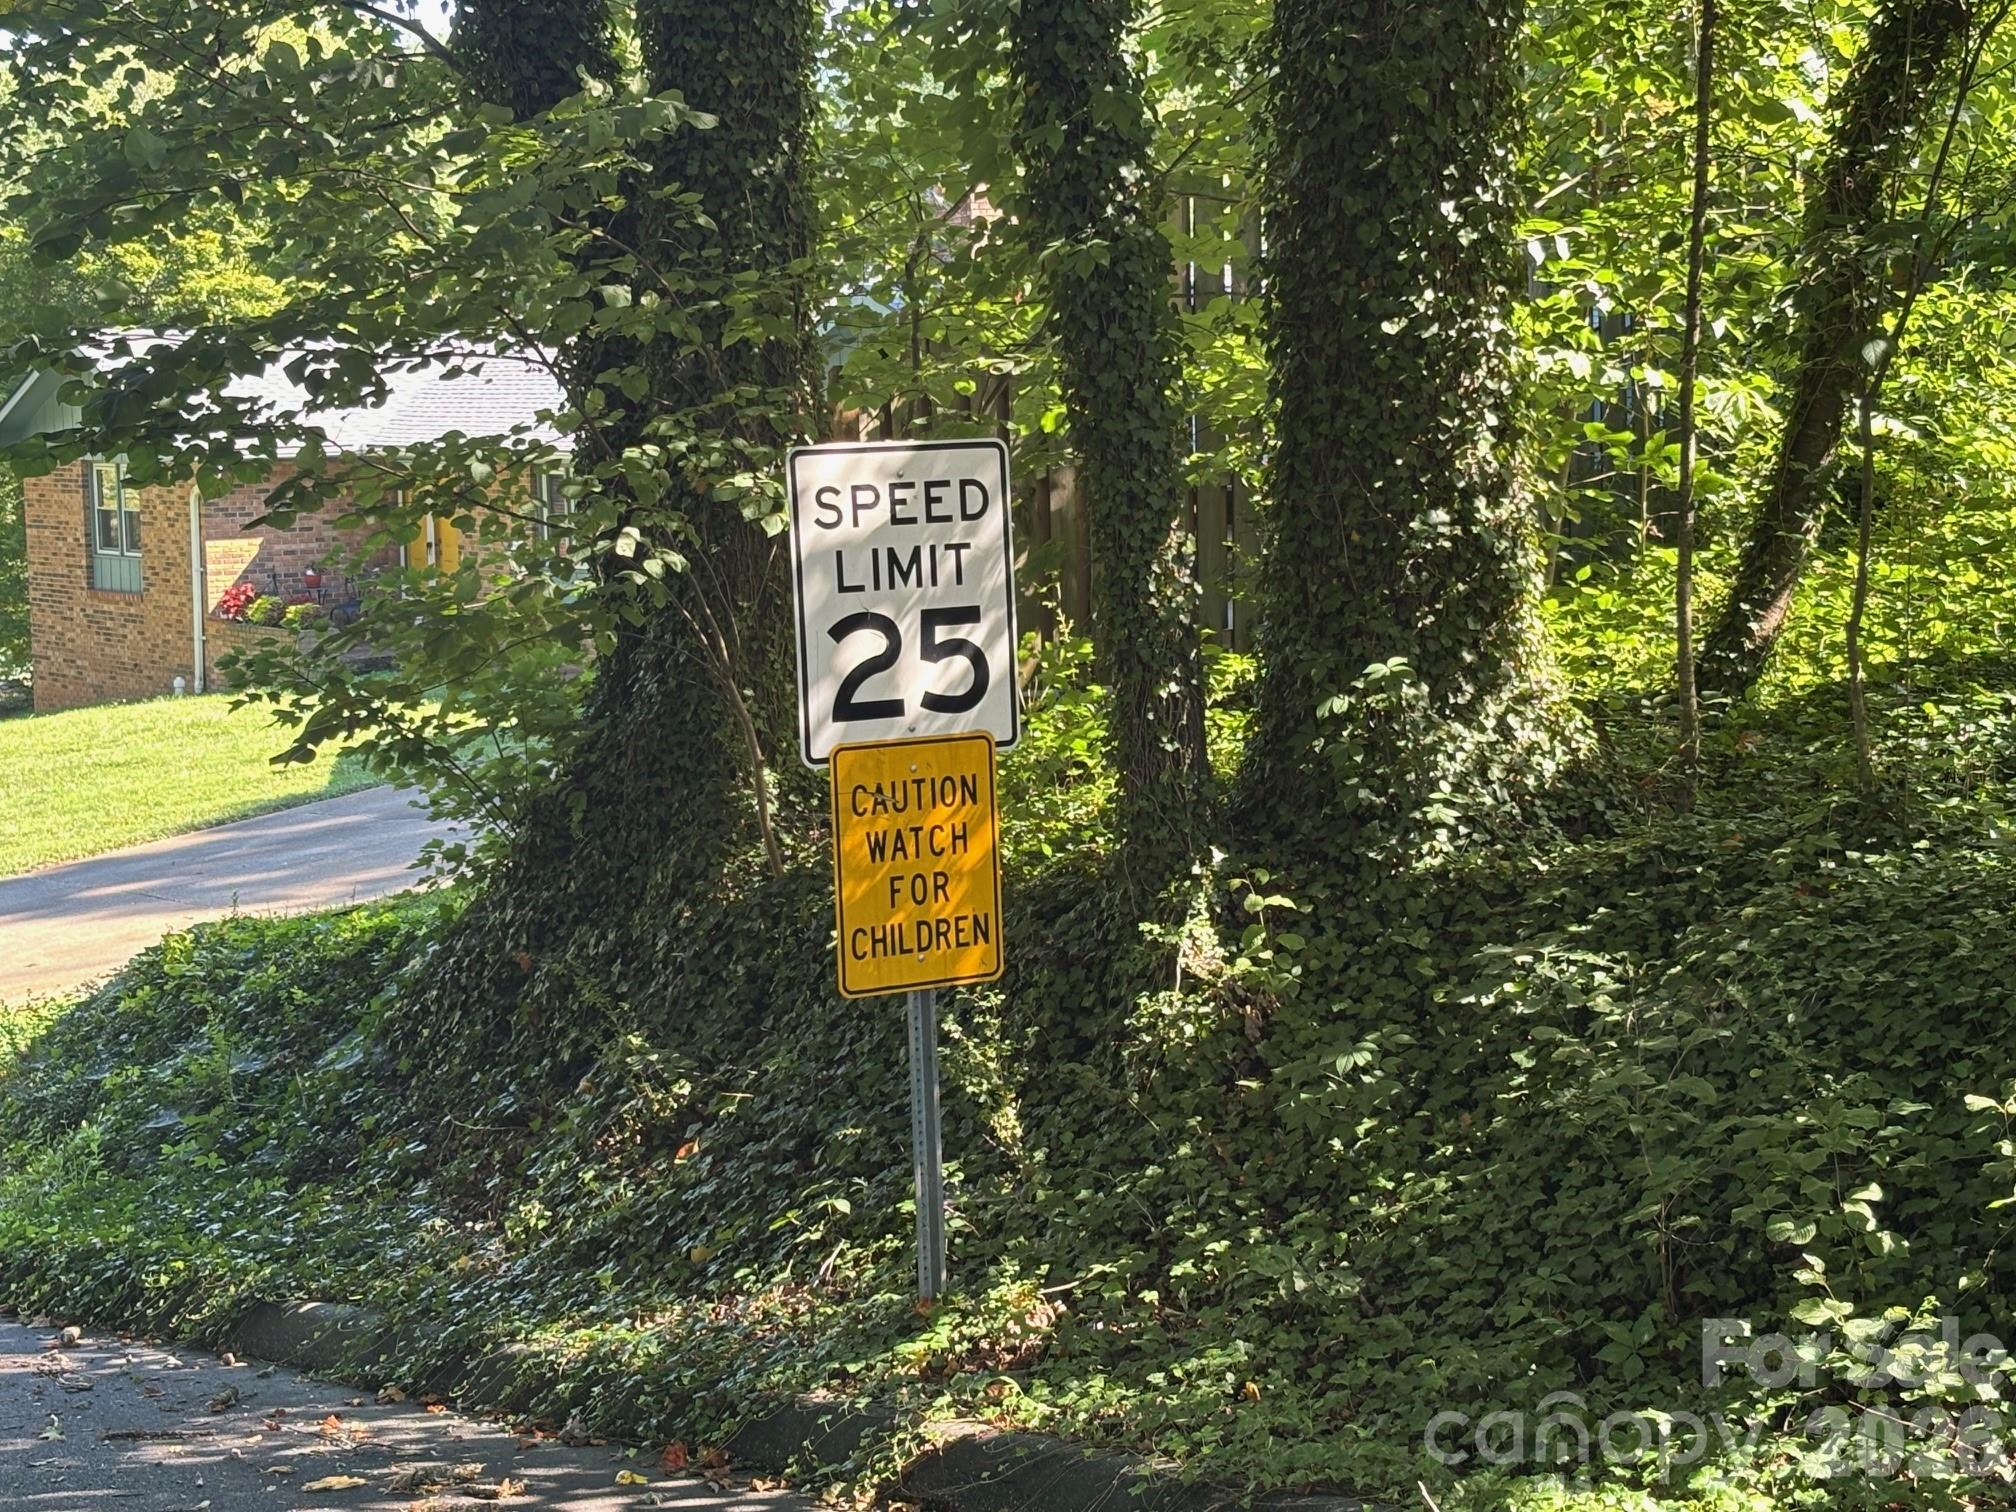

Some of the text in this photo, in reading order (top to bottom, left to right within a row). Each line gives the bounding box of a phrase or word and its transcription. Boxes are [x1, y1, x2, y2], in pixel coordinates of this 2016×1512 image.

[814, 478, 990, 530] SPEED
[835, 542, 971, 594] LIMIT
[826, 605, 990, 722] 25
[851, 773, 978, 817] CAUTION
[866, 822, 968, 864] WATCH
[889, 871, 950, 909] FOR
[851, 912, 990, 960] CHILDREN
